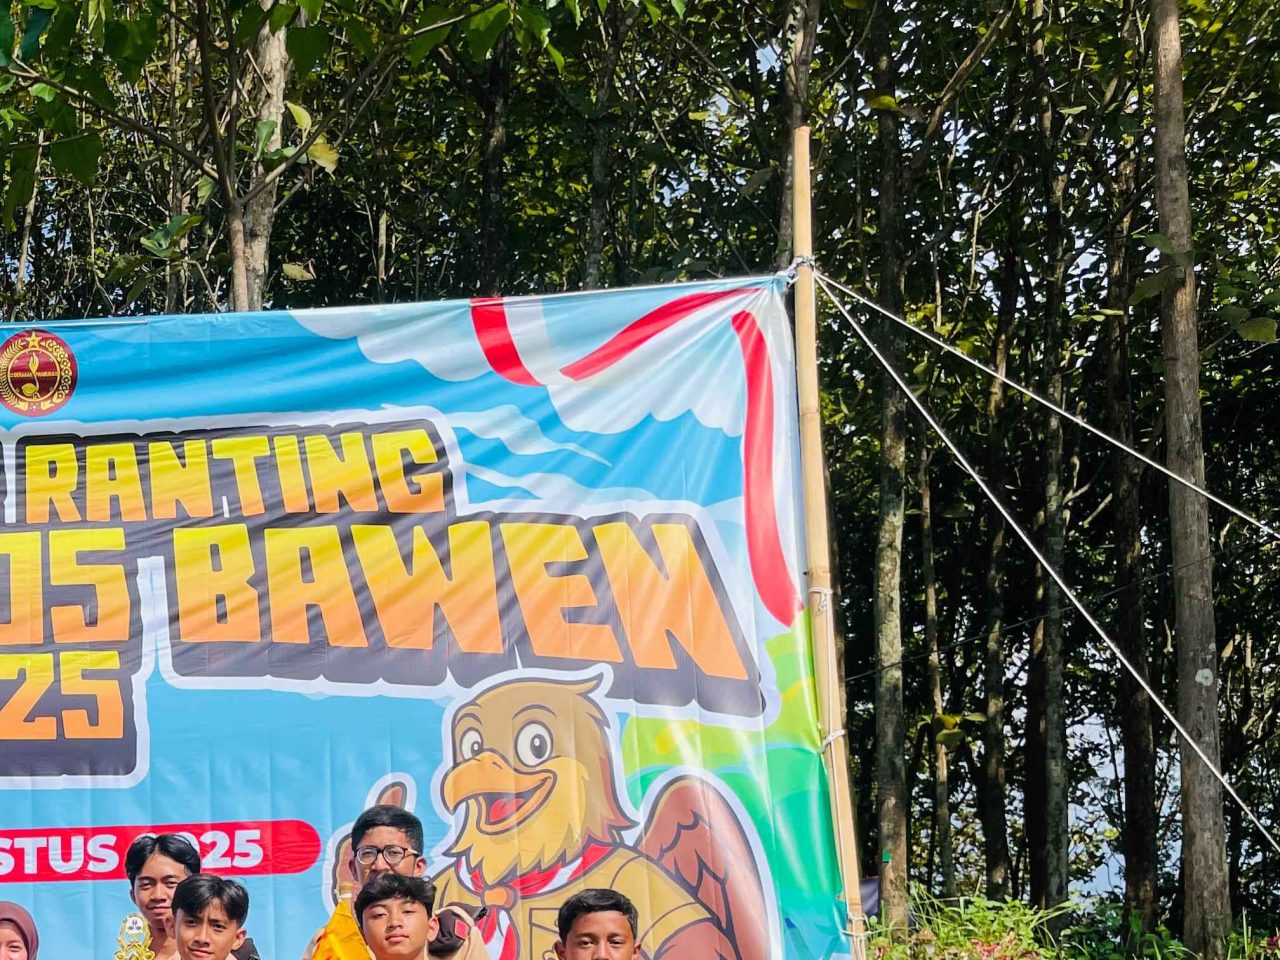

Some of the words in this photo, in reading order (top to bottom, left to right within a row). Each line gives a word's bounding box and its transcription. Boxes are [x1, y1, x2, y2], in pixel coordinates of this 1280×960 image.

[25, 428, 448, 524] RANTING
[173, 521, 753, 681] BAWEN
[131, 829, 264, 869] 25
